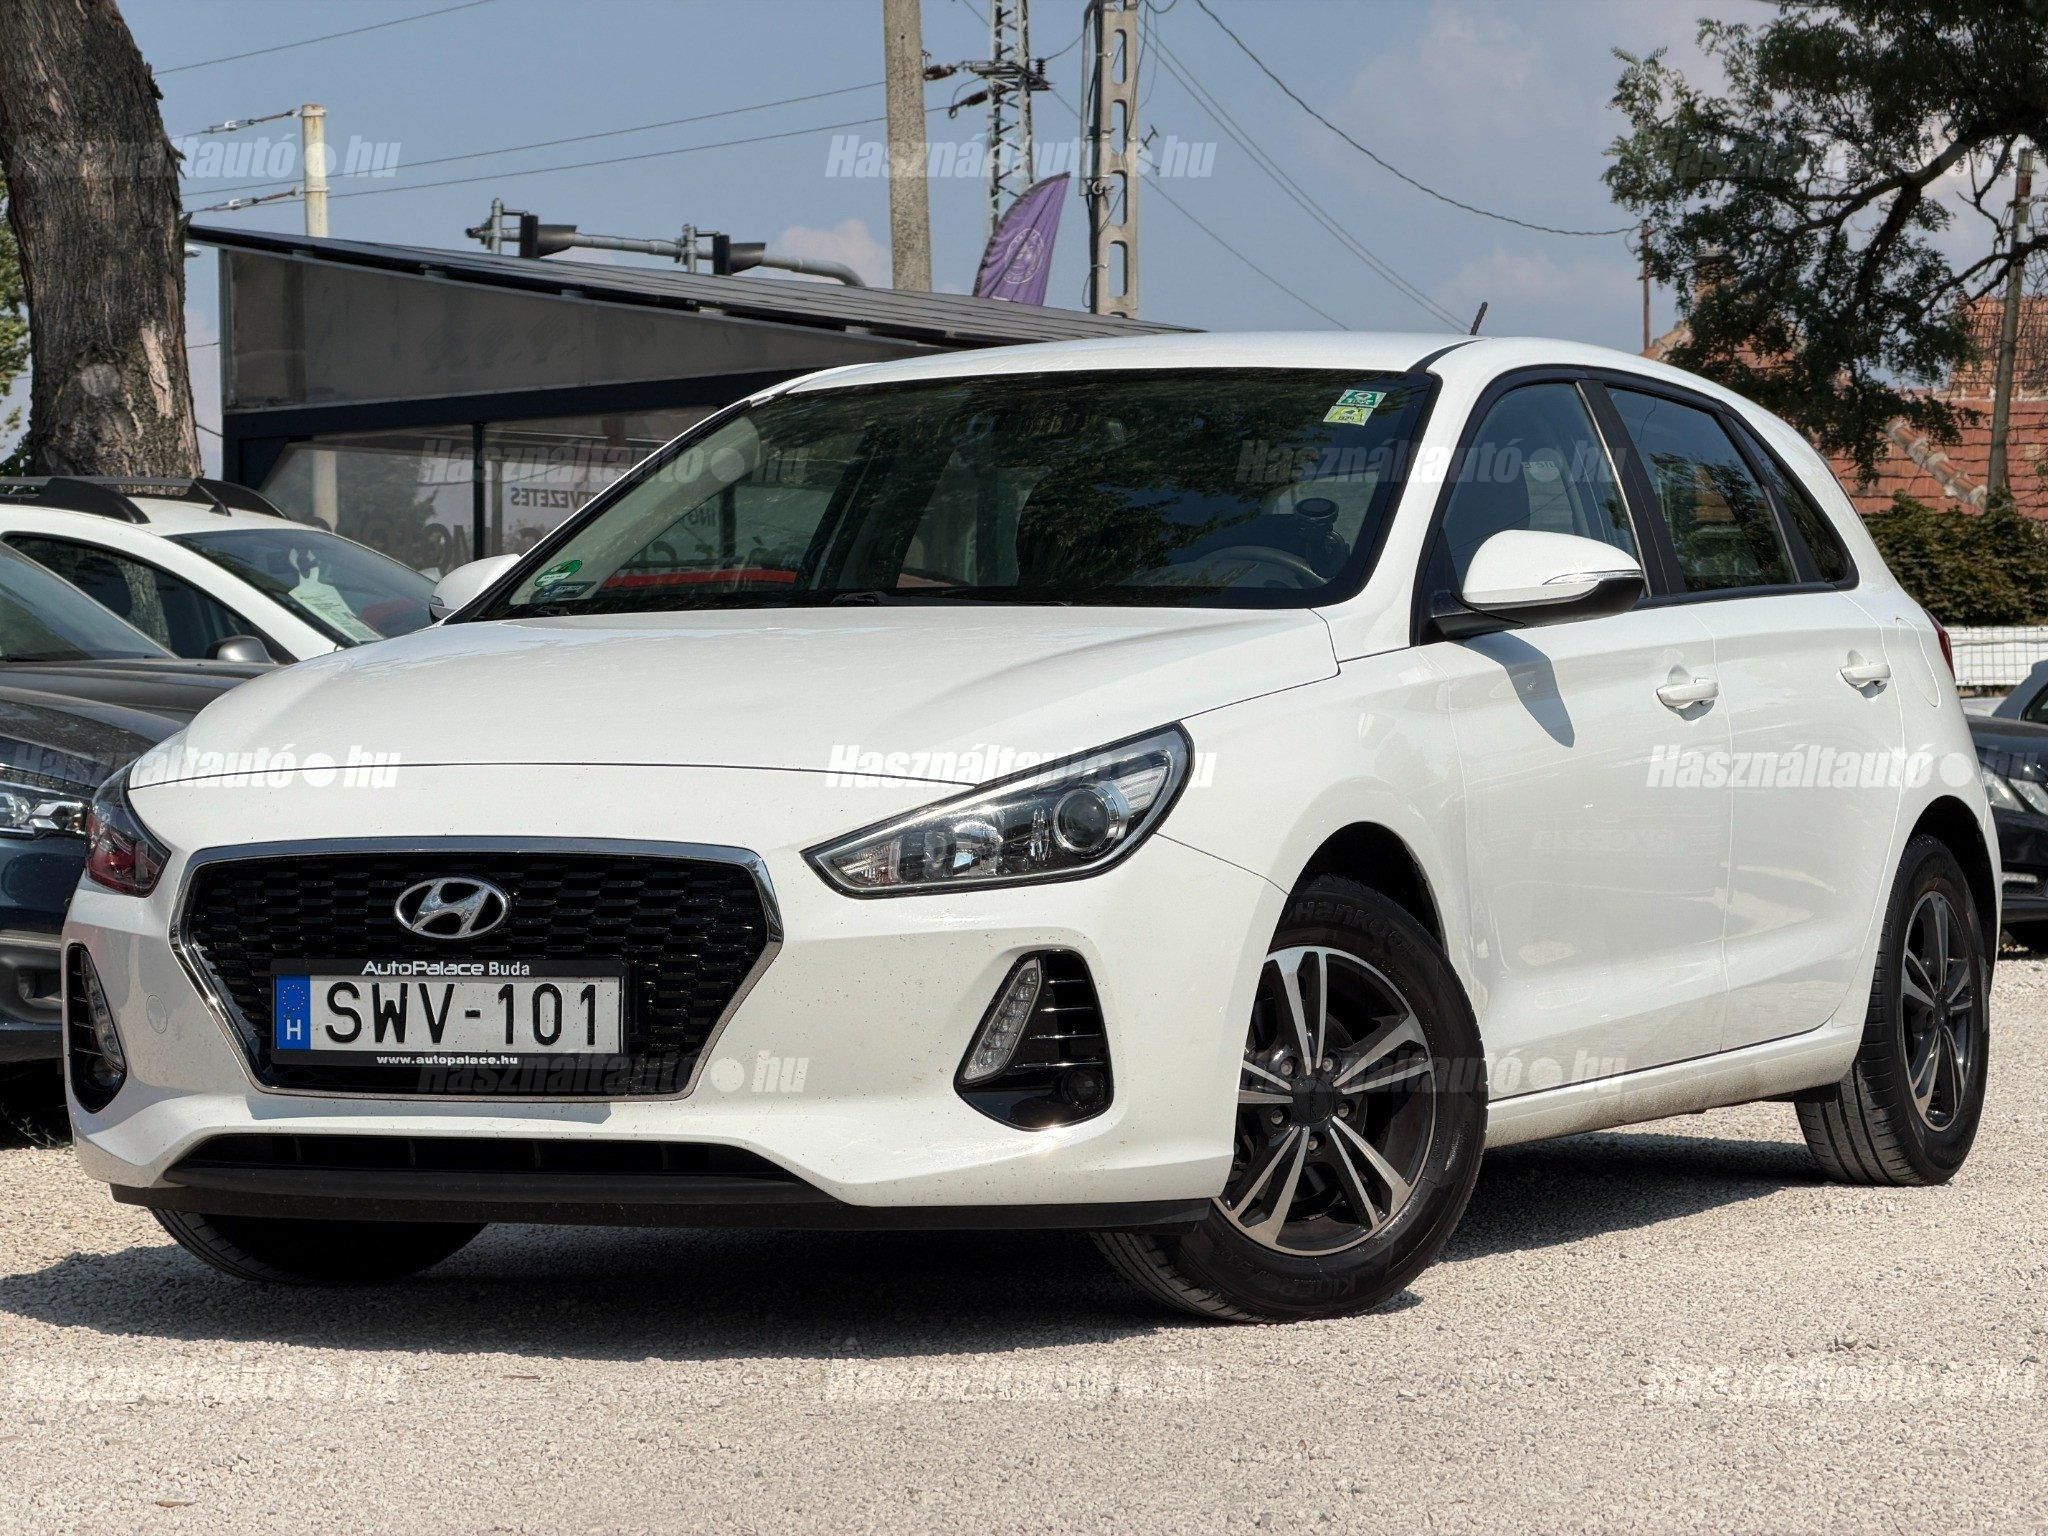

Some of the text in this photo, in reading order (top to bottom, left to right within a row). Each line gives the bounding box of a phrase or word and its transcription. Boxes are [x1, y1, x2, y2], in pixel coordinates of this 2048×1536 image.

[361, 960, 530, 976] AutoPalace Buda
[325, 981, 597, 1045] SWV-101
[286, 1018, 301, 1041] H
[376, 1054, 518, 1066] www.autopalace.hu
